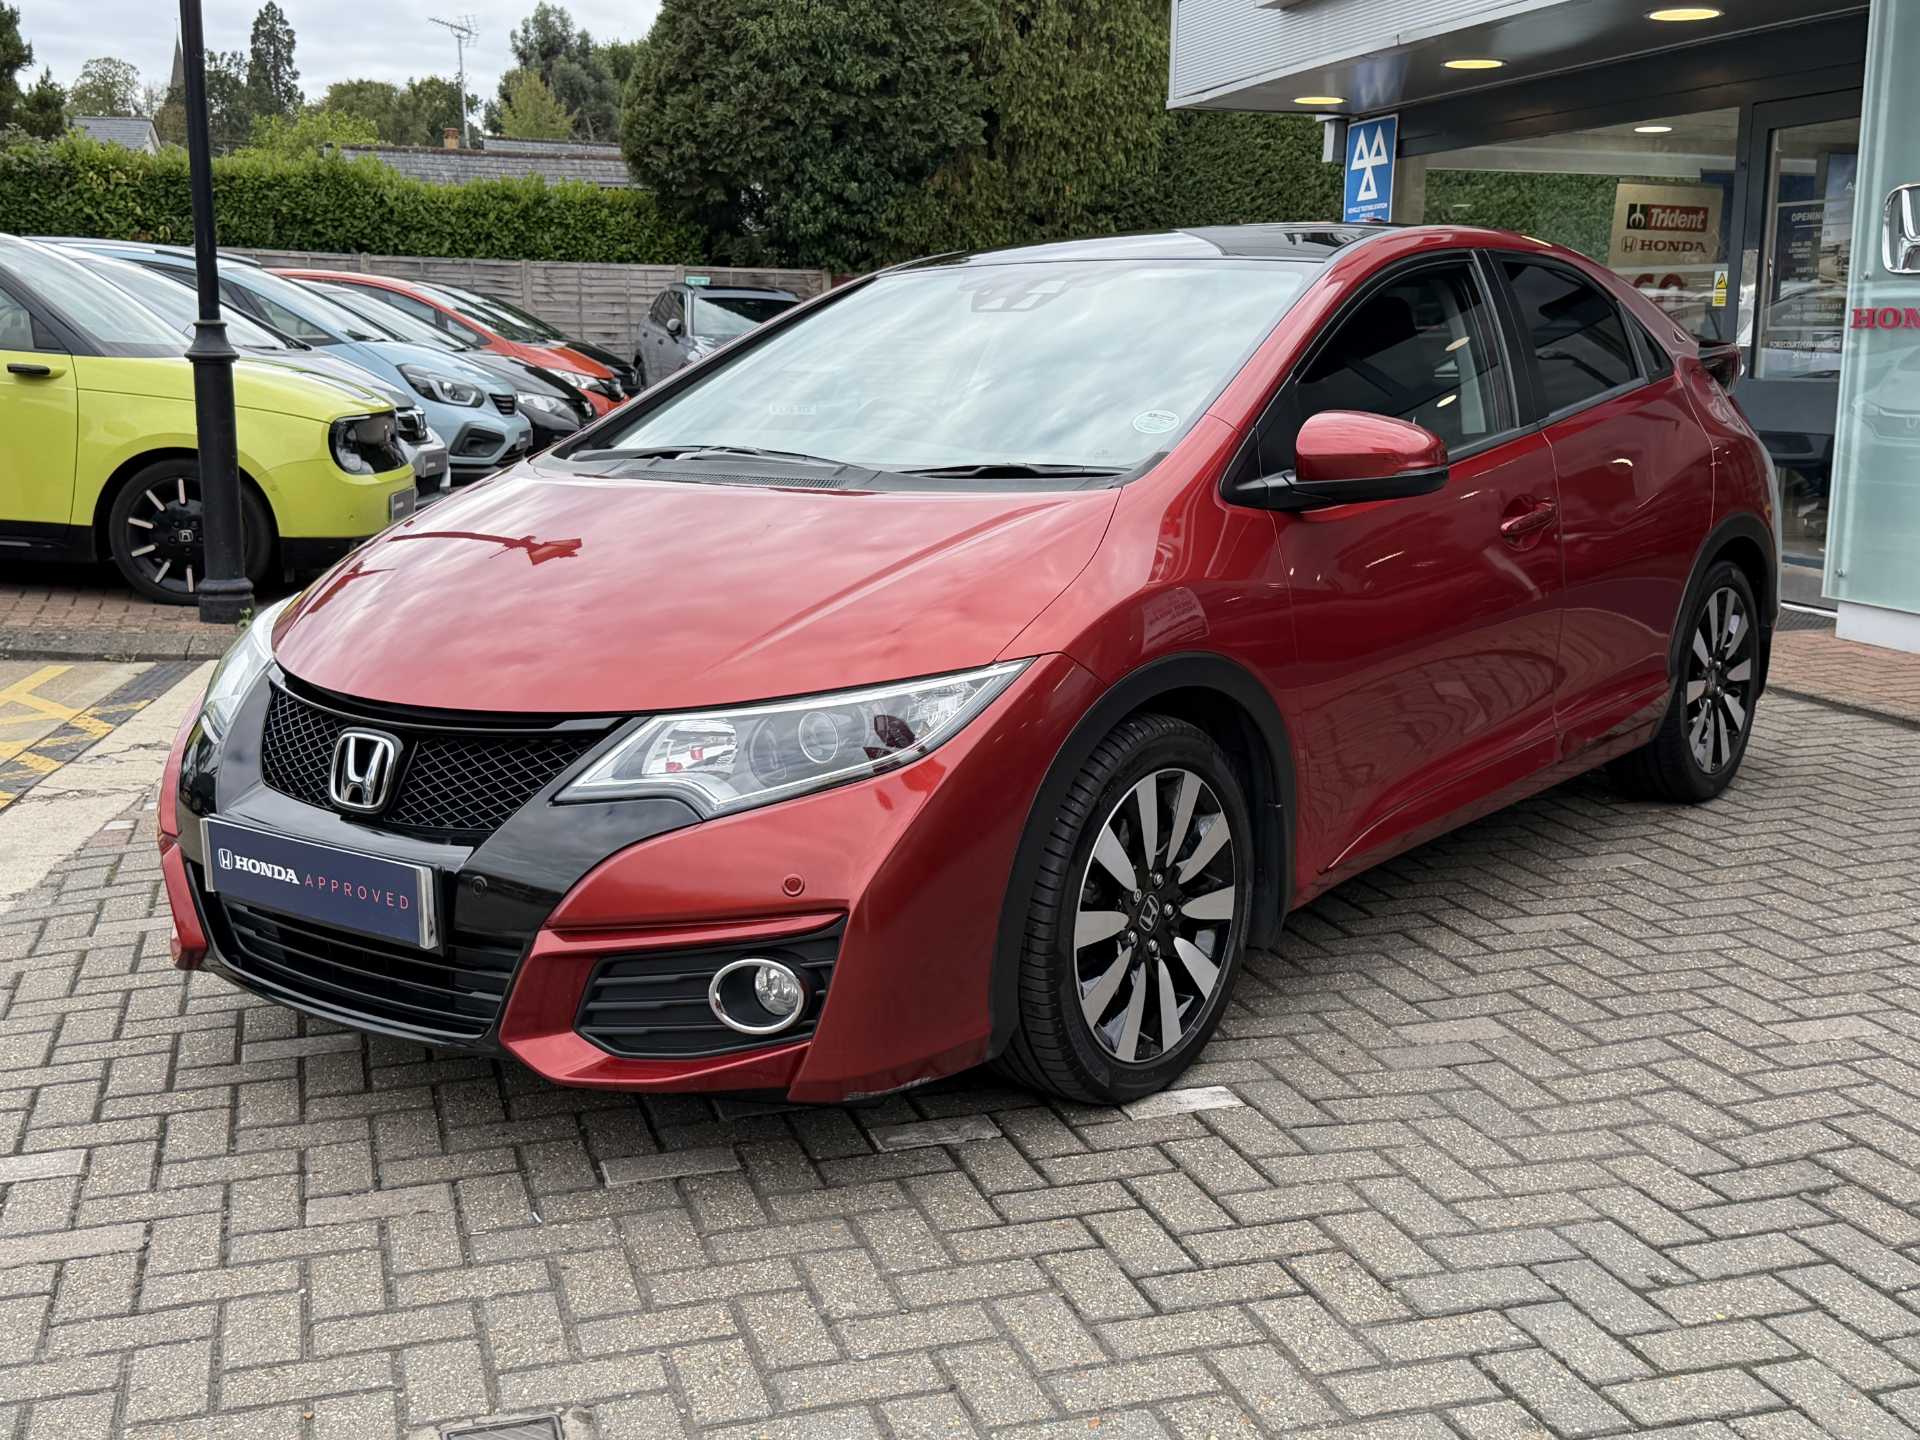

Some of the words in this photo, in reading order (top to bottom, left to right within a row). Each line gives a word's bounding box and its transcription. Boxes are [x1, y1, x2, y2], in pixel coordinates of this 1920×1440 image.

[1649, 208, 1705, 229] Trident
[1639, 240, 1707, 253] HONDA
[1850, 307, 1920, 330] HON
[234, 855, 300, 885] HONDA
[304, 873, 409, 910] APPROVED
